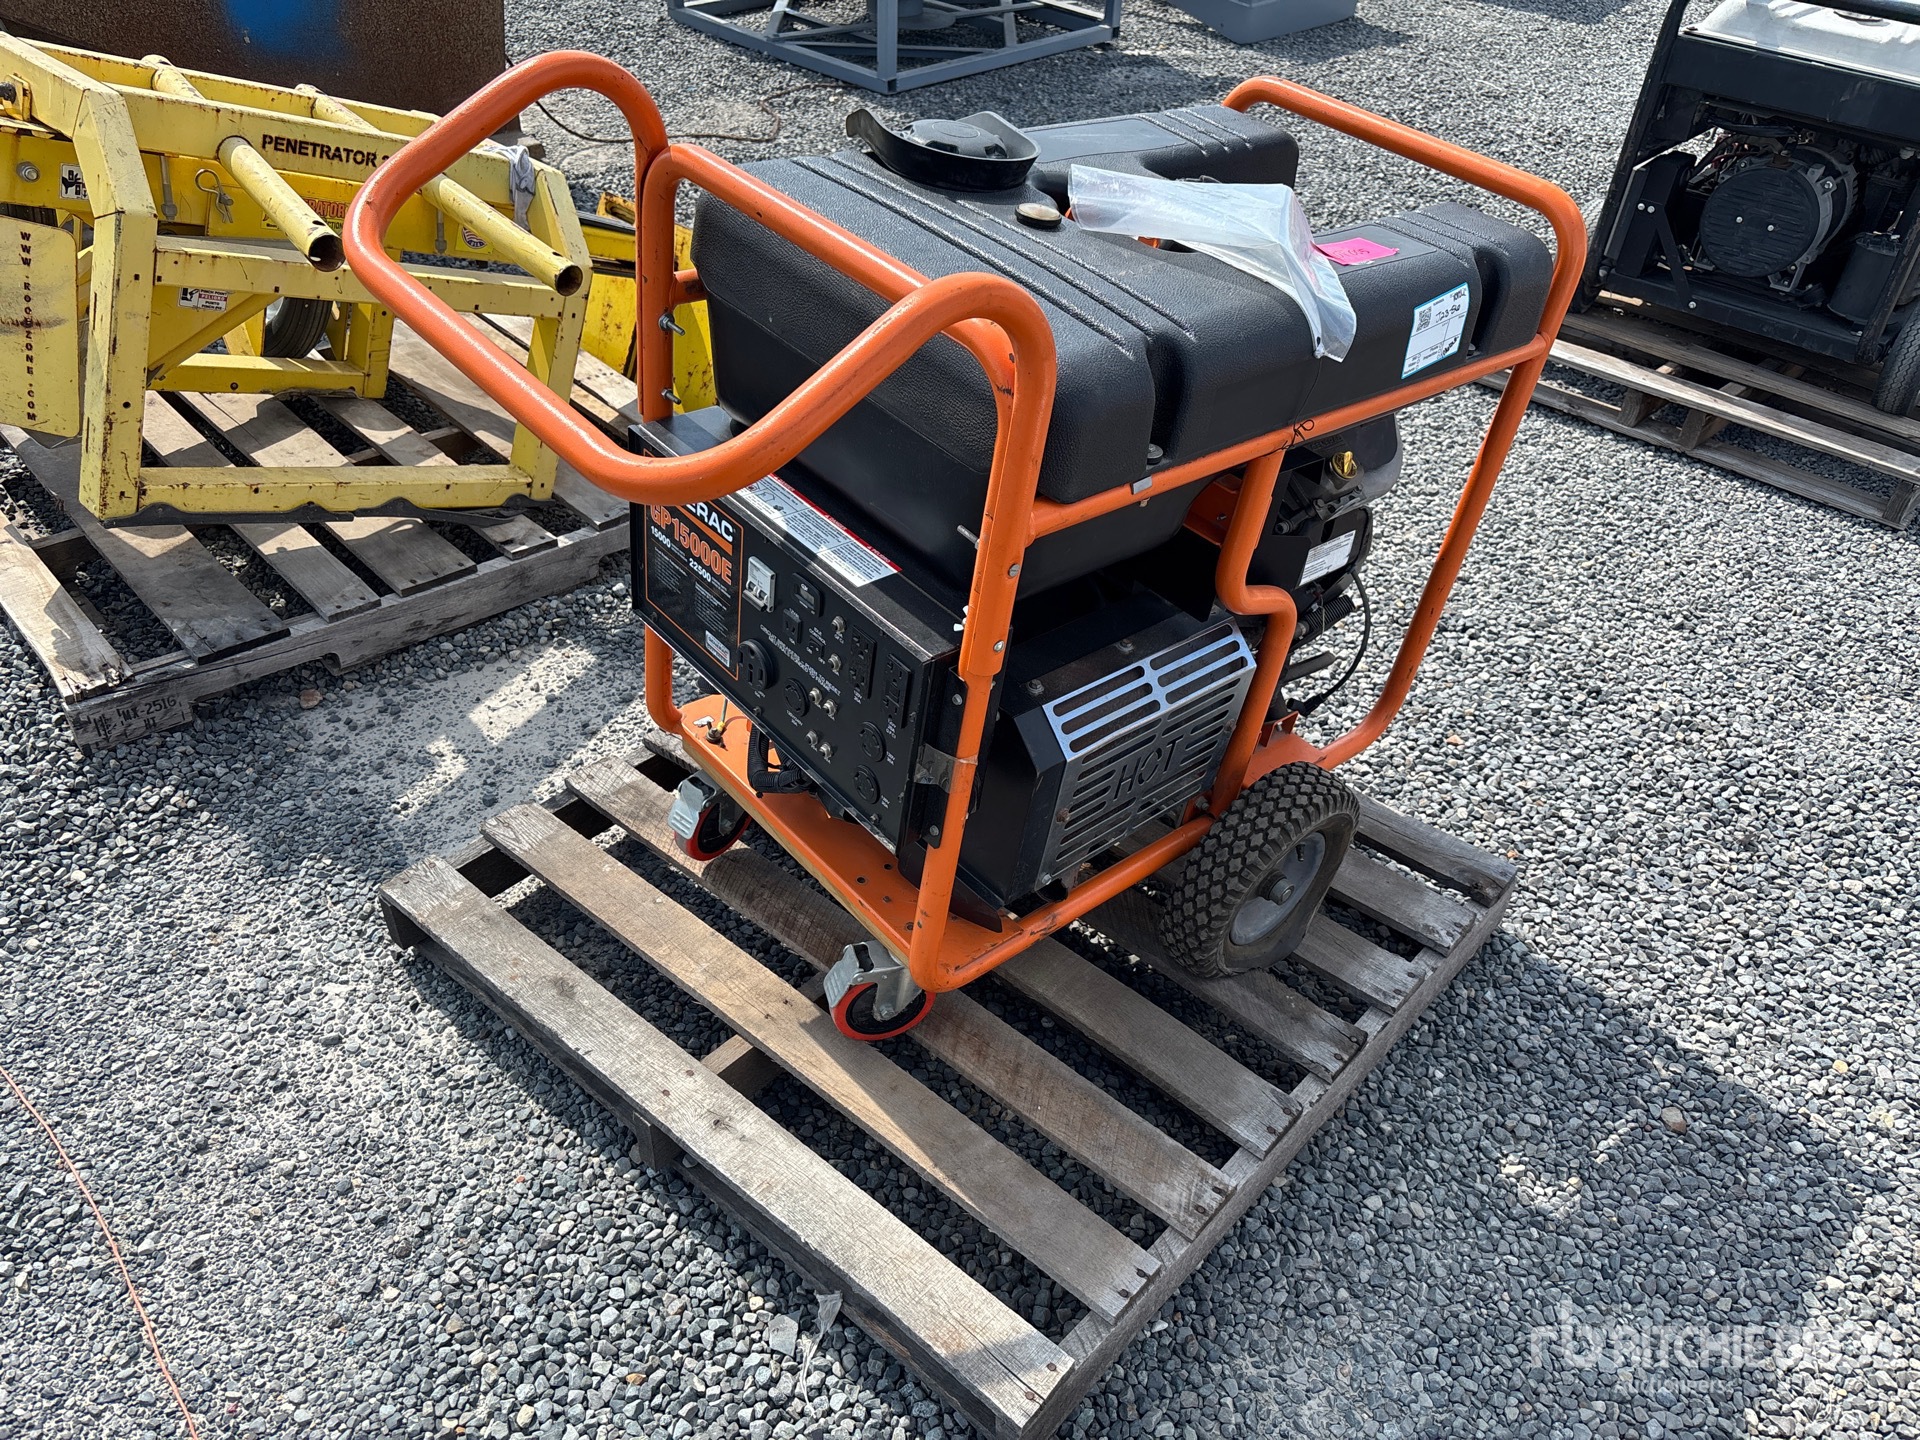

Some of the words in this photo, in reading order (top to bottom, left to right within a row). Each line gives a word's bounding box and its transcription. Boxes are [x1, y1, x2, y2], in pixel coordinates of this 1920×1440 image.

[262, 134, 377, 167] PENETRATOR
[305, 198, 346, 218] RATOR
[830, 516, 848, 531] DANGER
[650, 504, 732, 586] GP15000E
[651, 525, 671, 548] 15000
[871, 548, 891, 564] PELIGRO
[688, 557, 712, 582] 22500
[120, 696, 178, 722] MX-2516
[1113, 734, 1184, 800] HOT
